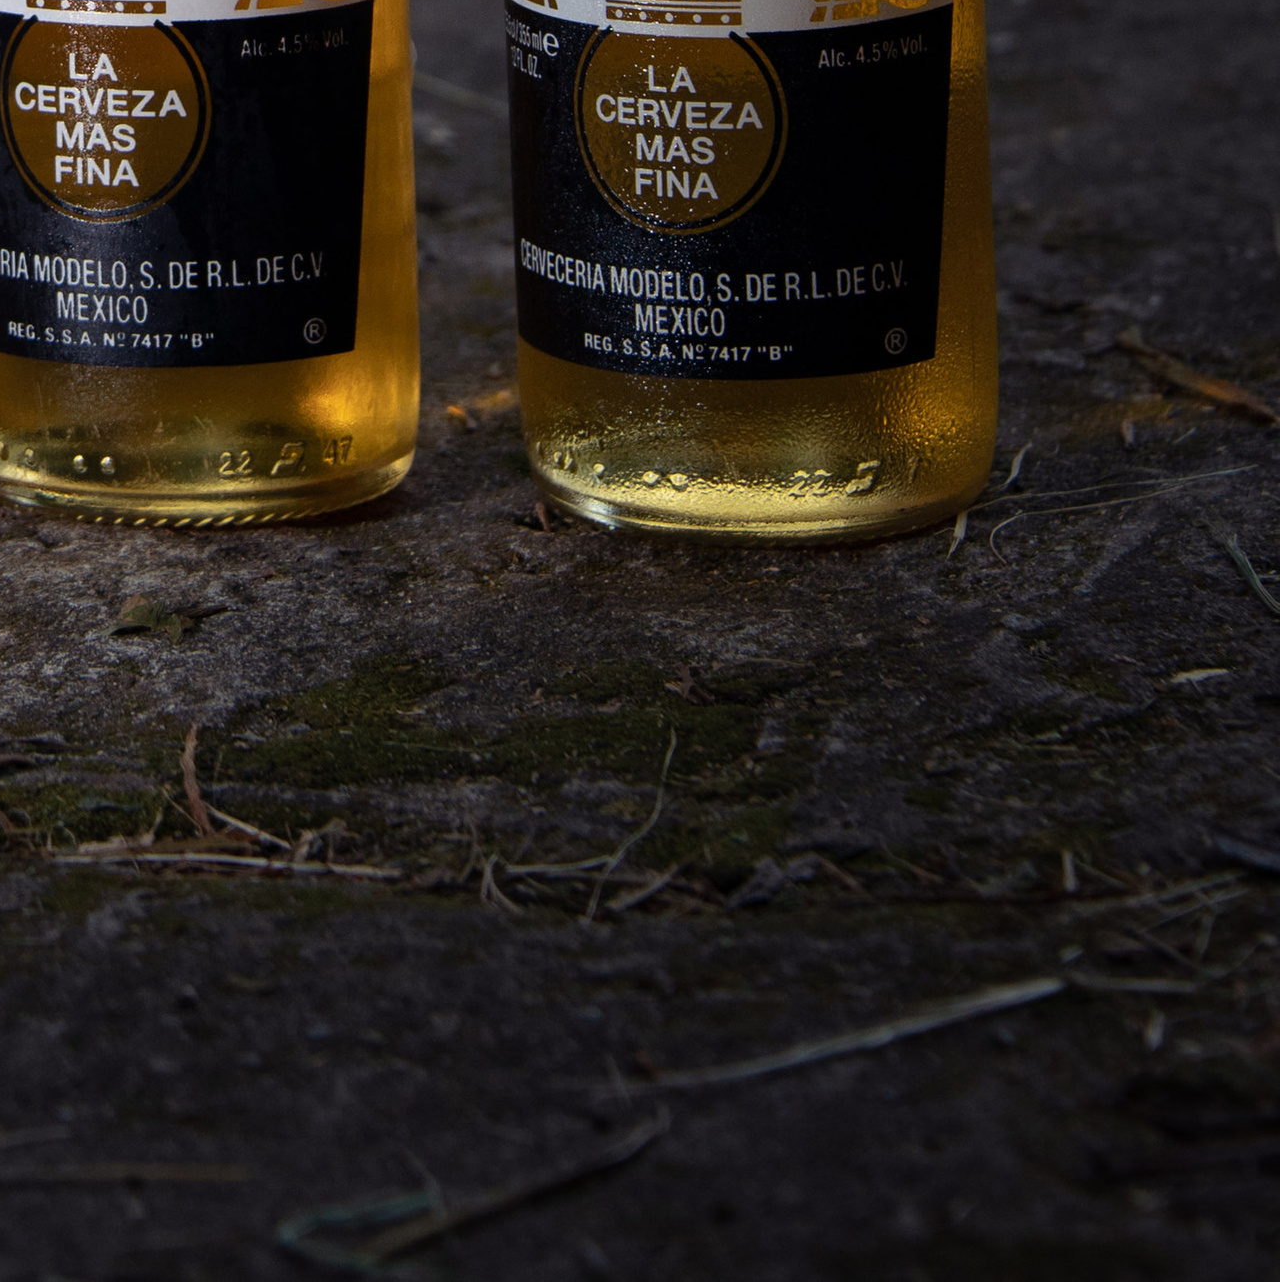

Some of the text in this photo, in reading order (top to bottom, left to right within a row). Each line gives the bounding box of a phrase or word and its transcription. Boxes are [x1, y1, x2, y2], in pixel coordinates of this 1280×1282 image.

[240, 37, 272, 59] Alc.
[818, 47, 851, 69] Alc.
[69, 53, 117, 82] LA
[647, 65, 696, 94] LA
[15, 82, 187, 118] CERVEZA
[595, 94, 763, 130] CERVEZA
[56, 122, 136, 153] MAS
[635, 133, 716, 166] MAS
[54, 155, 139, 188] FINA
[635, 168, 718, 200] FINA
[34, 255, 135, 294] MODELO,
[140, 261, 162, 290] S.
[169, 261, 197, 291] DE
[256, 256, 284, 285] DE
[291, 251, 328, 282] C.V.
[520, 237, 606, 293] CERVECERIA
[610, 267, 711, 305] MODELO,
[717, 273, 739, 302] S.
[745, 273, 777, 302] DE
[836, 267, 866, 297] DE
[872, 259, 908, 293] C.V.
[56, 291, 148, 324] MEXICO
[634, 302, 726, 337] MEXICO
[8, 320, 43, 343] REG.
[131, 332, 173, 349] 7417
[584, 332, 618, 354] REG.
[709, 345, 751, 362] 7417
